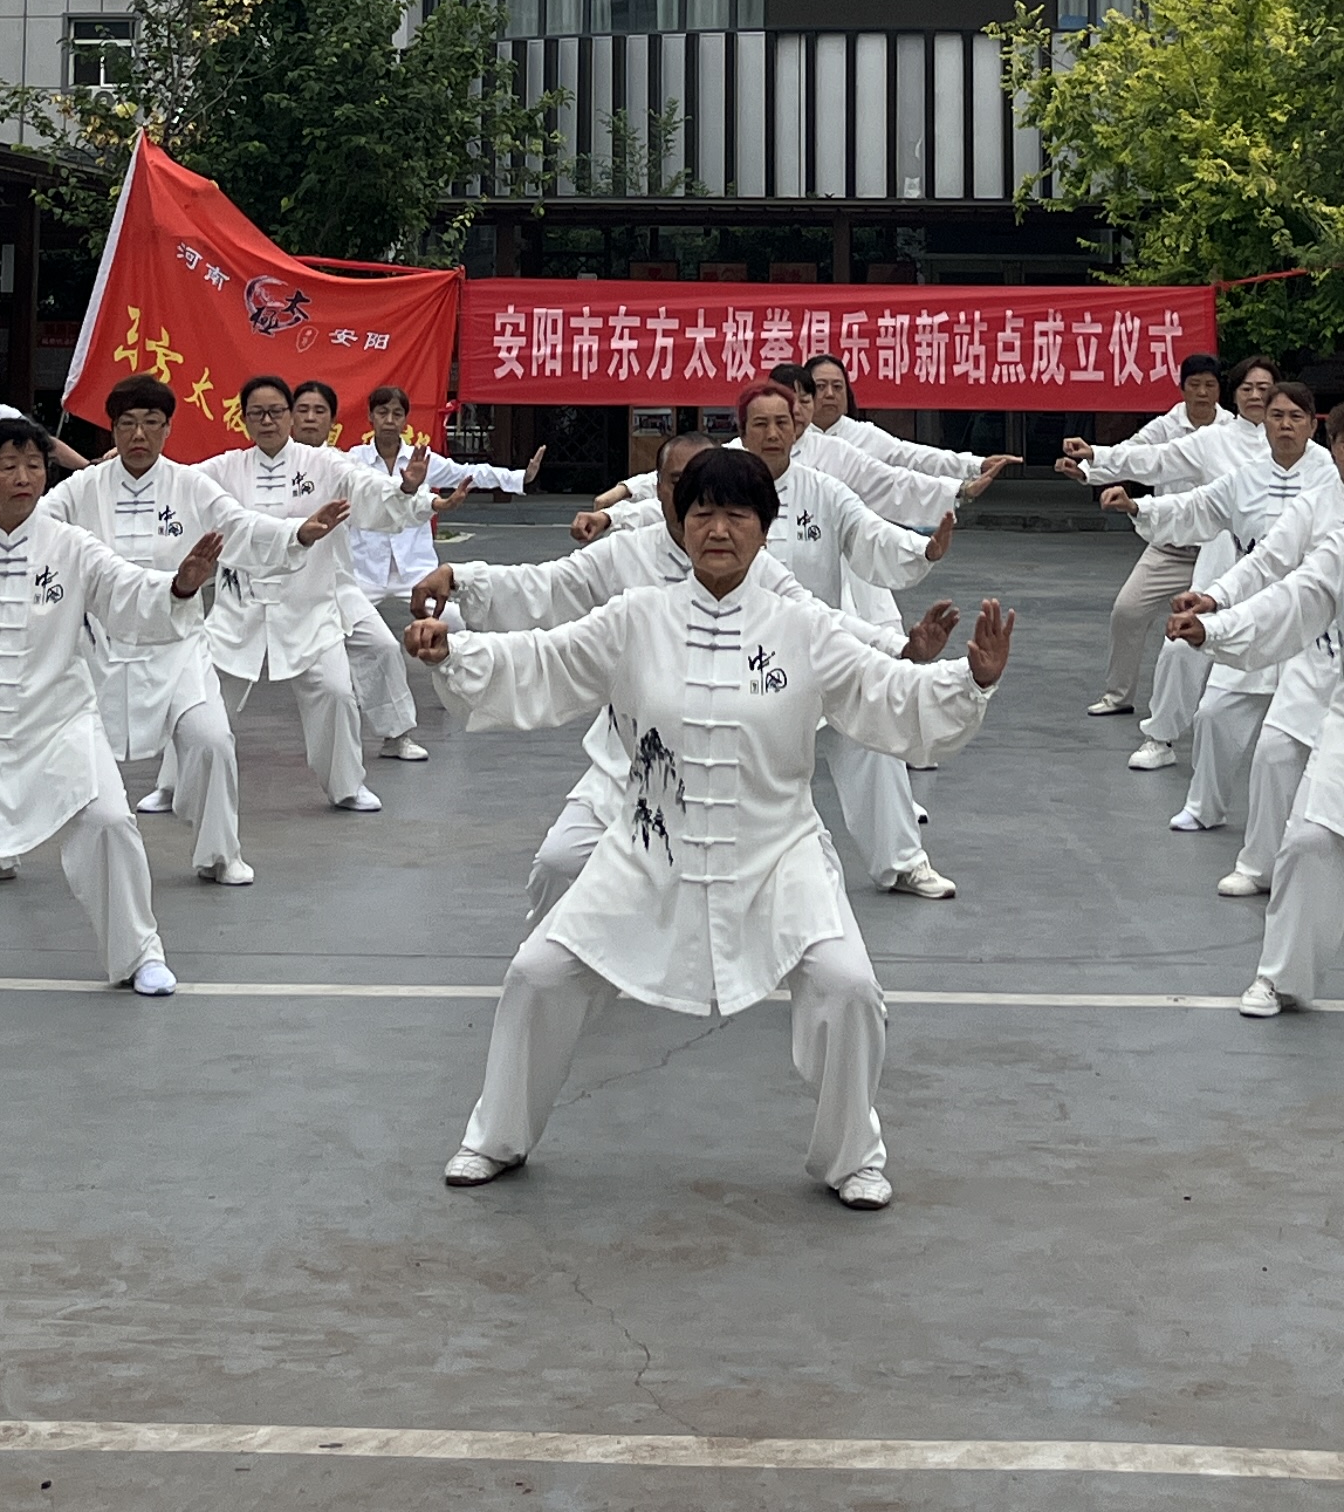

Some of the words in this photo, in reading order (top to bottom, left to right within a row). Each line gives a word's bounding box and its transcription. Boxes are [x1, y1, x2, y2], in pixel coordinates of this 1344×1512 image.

[176, 242, 231, 292] 河南
[328, 328, 392, 351] 安阳
[747, 644, 788, 696] 中国
